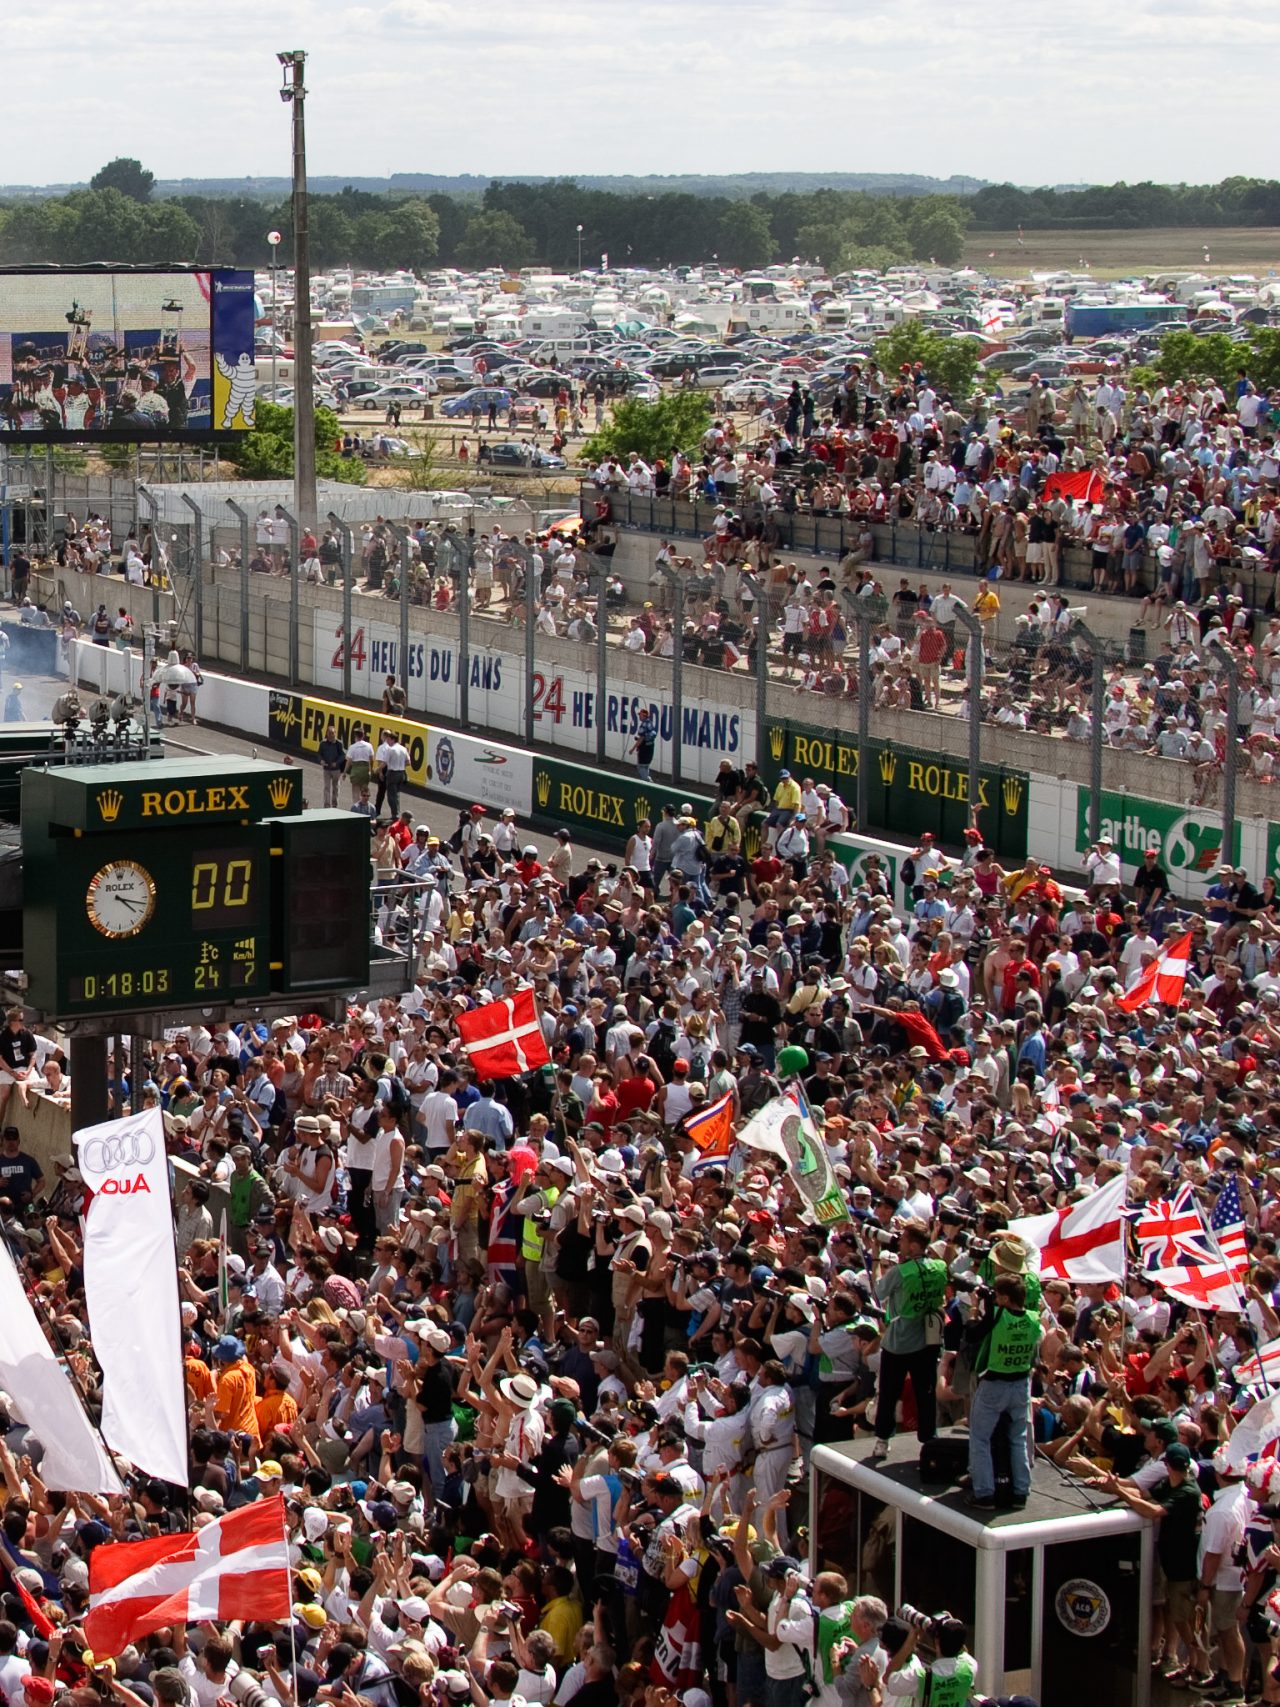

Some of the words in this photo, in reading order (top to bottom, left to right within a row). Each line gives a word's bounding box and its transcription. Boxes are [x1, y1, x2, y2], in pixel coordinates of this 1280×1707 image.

[371, 640, 424, 678] HEUES
[430, 648, 452, 683] DU
[457, 652, 503, 691] ANS
[269, 697, 303, 738] info
[524, 670, 567, 724] 24
[573, 690, 639, 736] HERES
[682, 707, 740, 752] MANS
[141, 785, 250, 817] ROLEX
[559, 782, 625, 827] ROLEX
[105, 882, 135, 893] ROLEX
[192, 860, 252, 910] 00
[84, 969, 169, 999] 0:18:03
[194, 965, 220, 989] 24
[244, 961, 255, 984] 7
